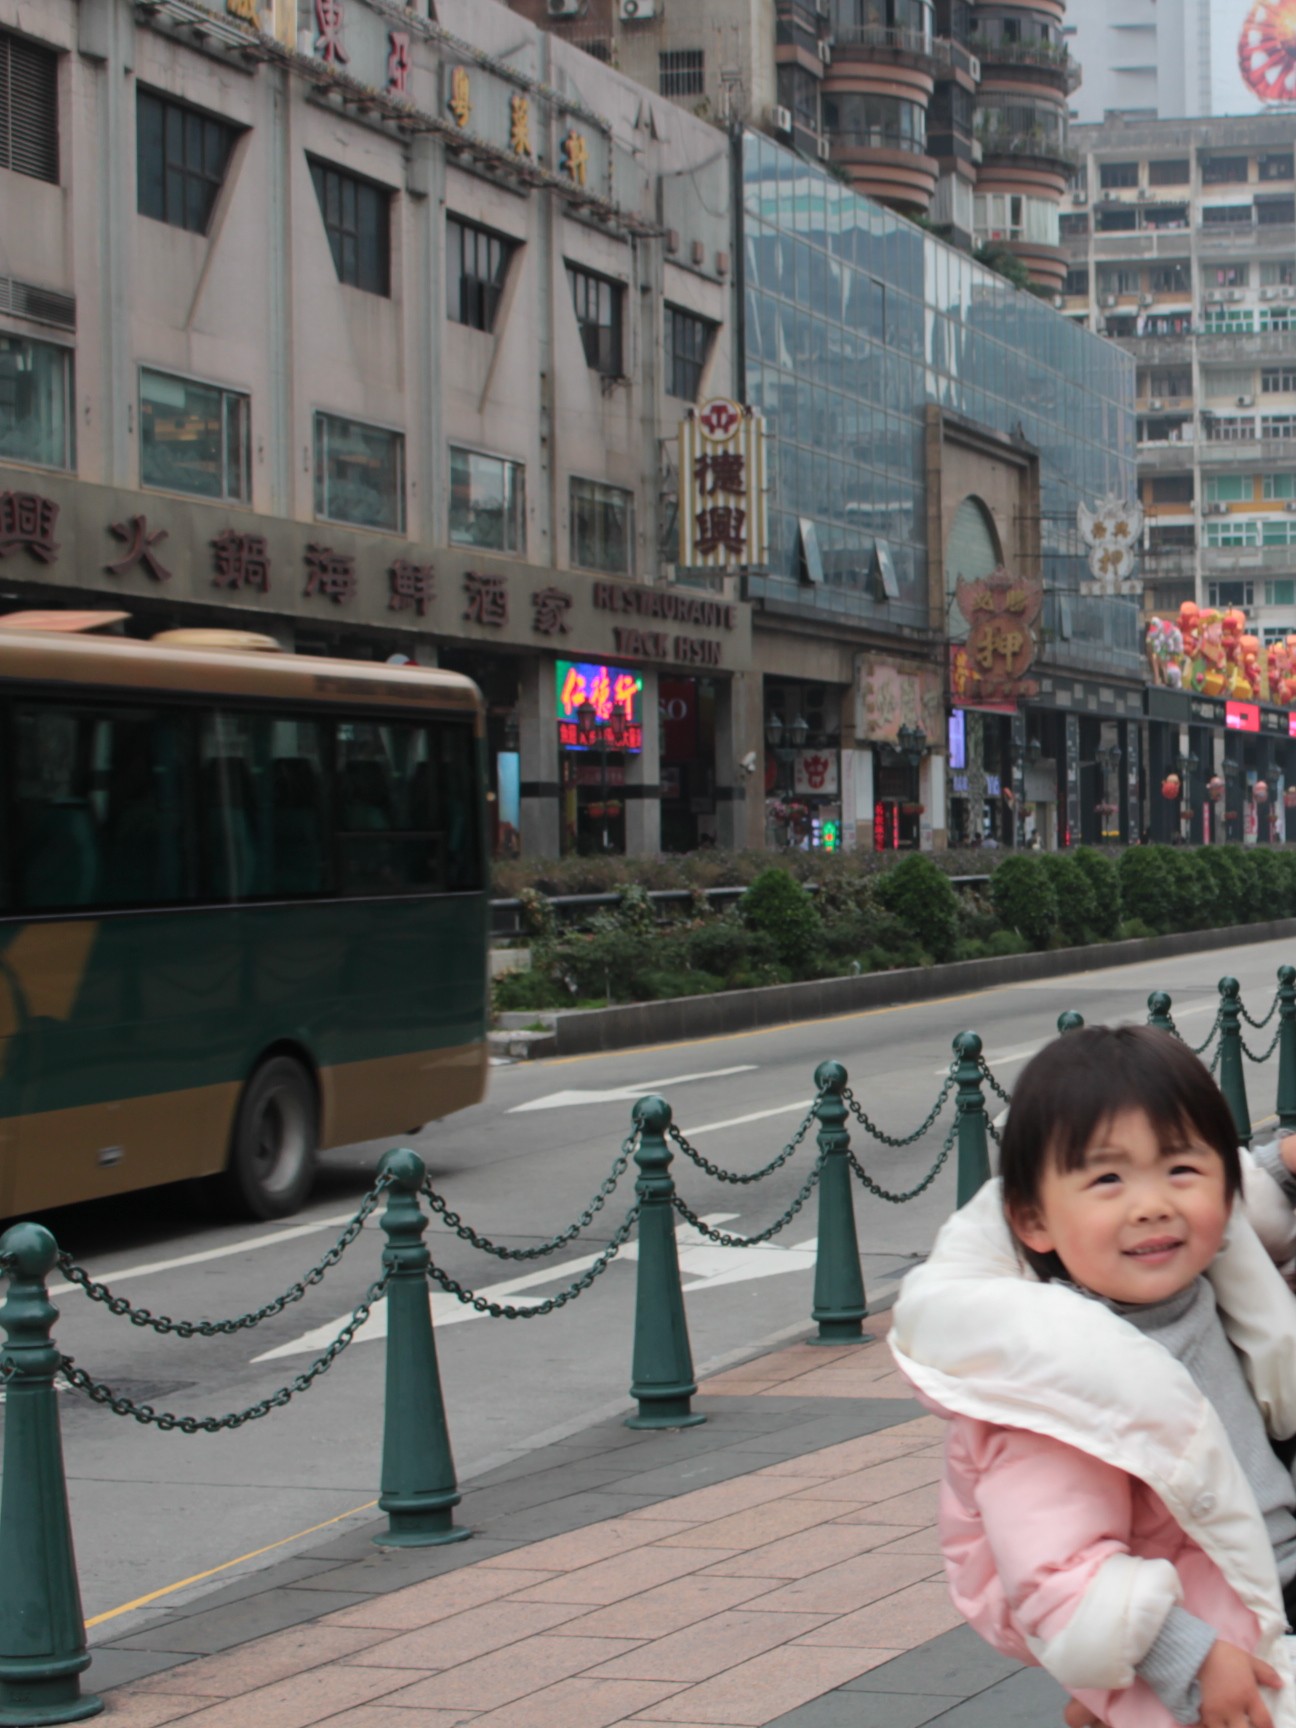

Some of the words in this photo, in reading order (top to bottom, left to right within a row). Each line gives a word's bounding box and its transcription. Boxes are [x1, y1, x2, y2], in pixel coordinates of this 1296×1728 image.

[694, 449, 747, 556] 德興
[593, 581, 737, 631] RESTAURANTE
[674, 635, 722, 666] HSIN
[976, 626, 1023, 673] 押
